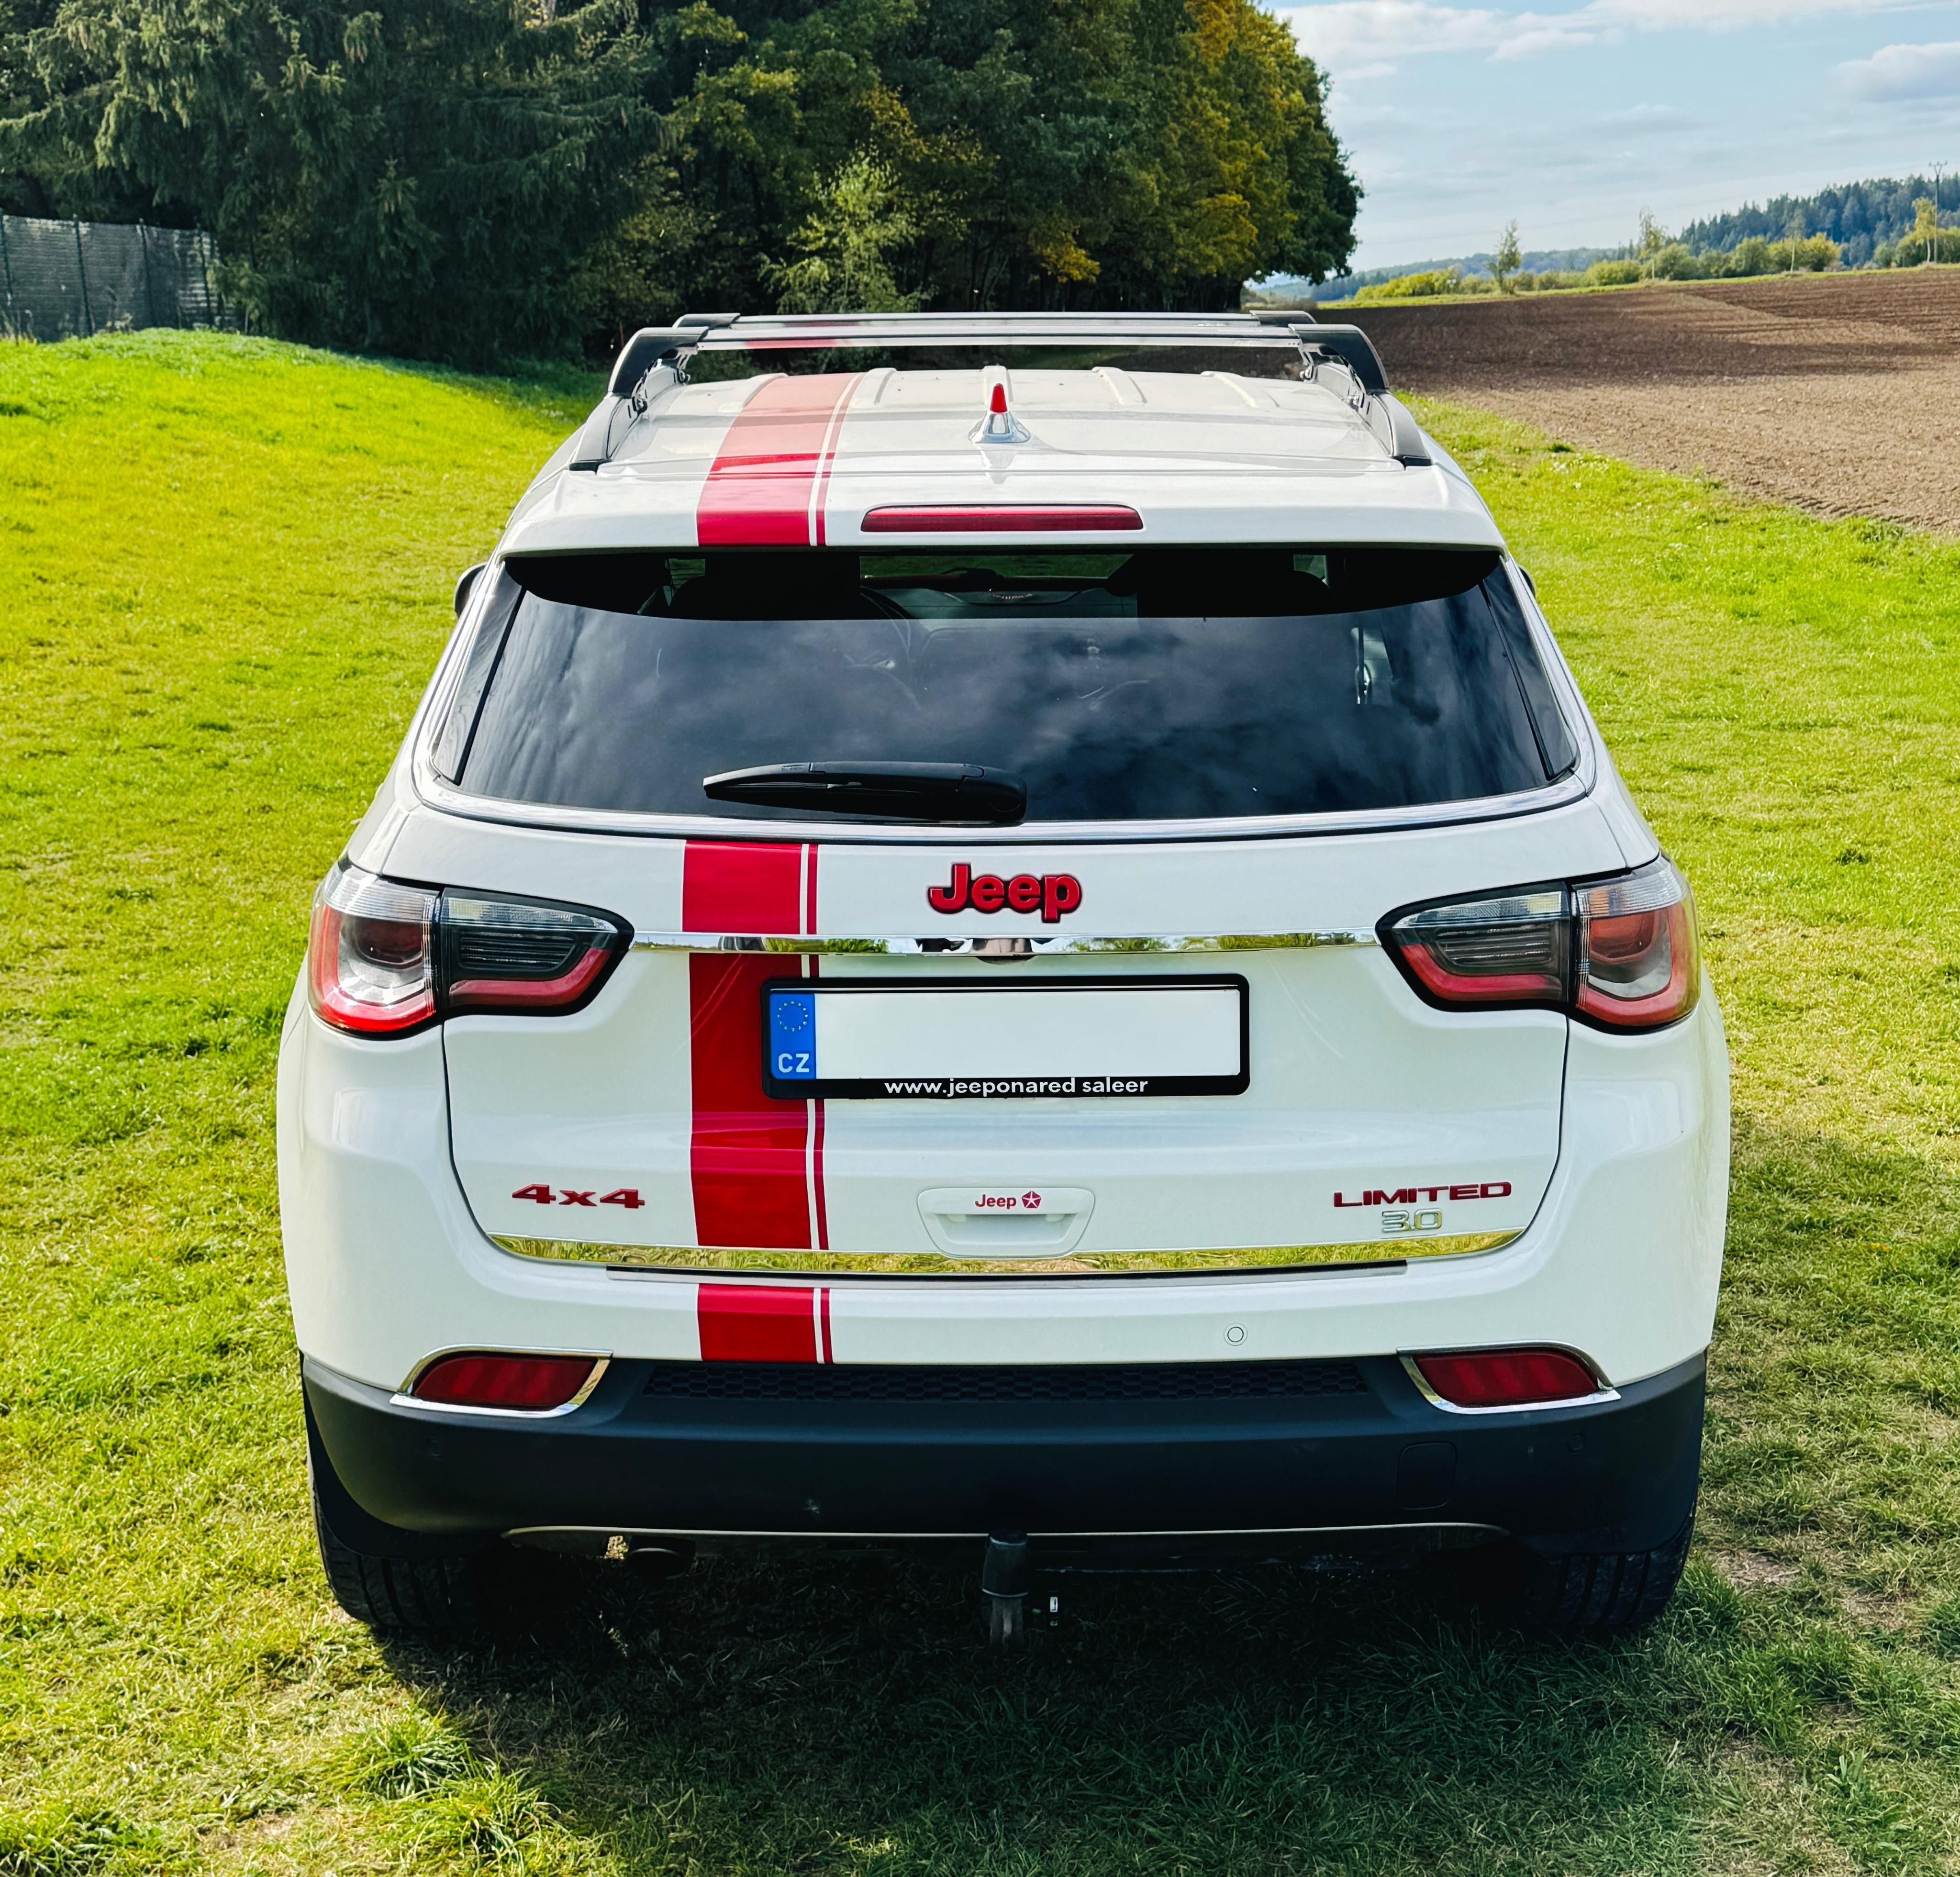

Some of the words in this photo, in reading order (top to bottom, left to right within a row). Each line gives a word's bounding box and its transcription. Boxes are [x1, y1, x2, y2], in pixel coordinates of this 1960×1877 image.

[927, 863, 1082, 923] Jeep
[779, 1054, 810, 1072] CZ
[884, 1077, 1075, 1097] www.jeeponared
[1082, 1077, 1148, 1093] saleer
[512, 1184, 645, 1209] 4x4
[975, 1194, 1017, 1210] Jeep
[1334, 1181, 1512, 1207] LIMITED
